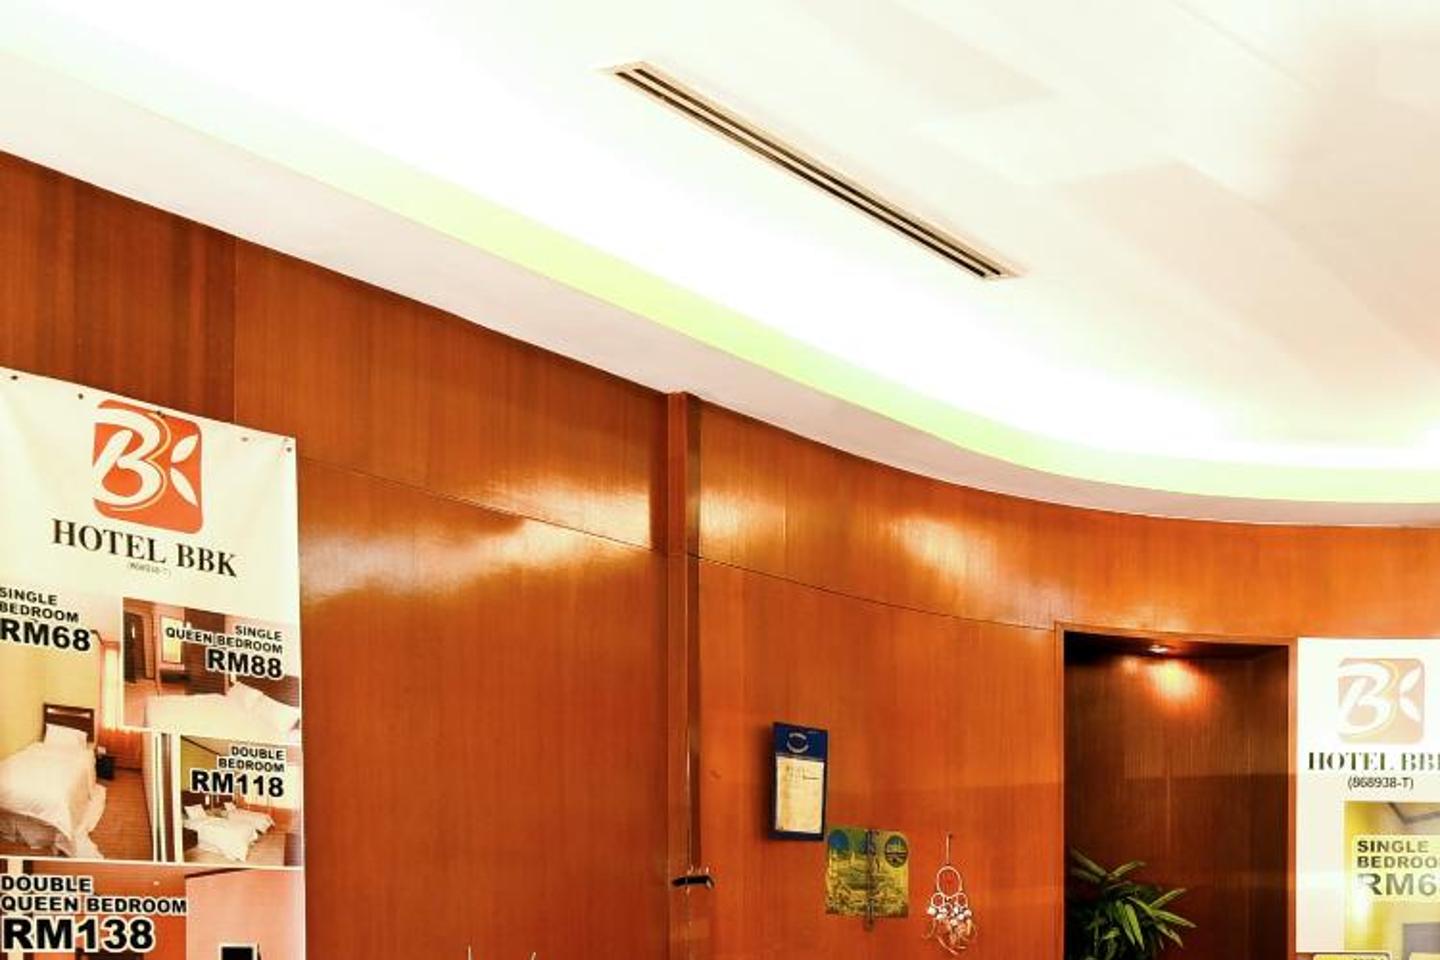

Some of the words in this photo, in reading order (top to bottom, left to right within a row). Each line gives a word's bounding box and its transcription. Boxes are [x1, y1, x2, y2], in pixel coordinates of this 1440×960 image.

[52, 518, 167, 565] HOTEL
[176, 542, 238, 578] BBK
[0, 586, 57, 606] SINGLE
[0, 600, 79, 623] BEDROOM
[0, 617, 91, 651] RM68
[166, 627, 213, 645] QUEEN
[218, 634, 283, 654] BEDROOM
[235, 625, 282, 642] SINGLE
[208, 648, 282, 679] RM88
[231, 746, 285, 760] DOUBLE
[1308, 752, 1394, 771] HOTEL
[218, 758, 285, 773] BEDROOM
[191, 769, 284, 797] RM118
[1357, 840, 1429, 853] SINGLE
[1, 876, 92, 892] DOUBLE
[1, 896, 79, 912] QUEEN
[87, 897, 187, 913] BEDROOM
[3, 918, 153, 950] RM138
